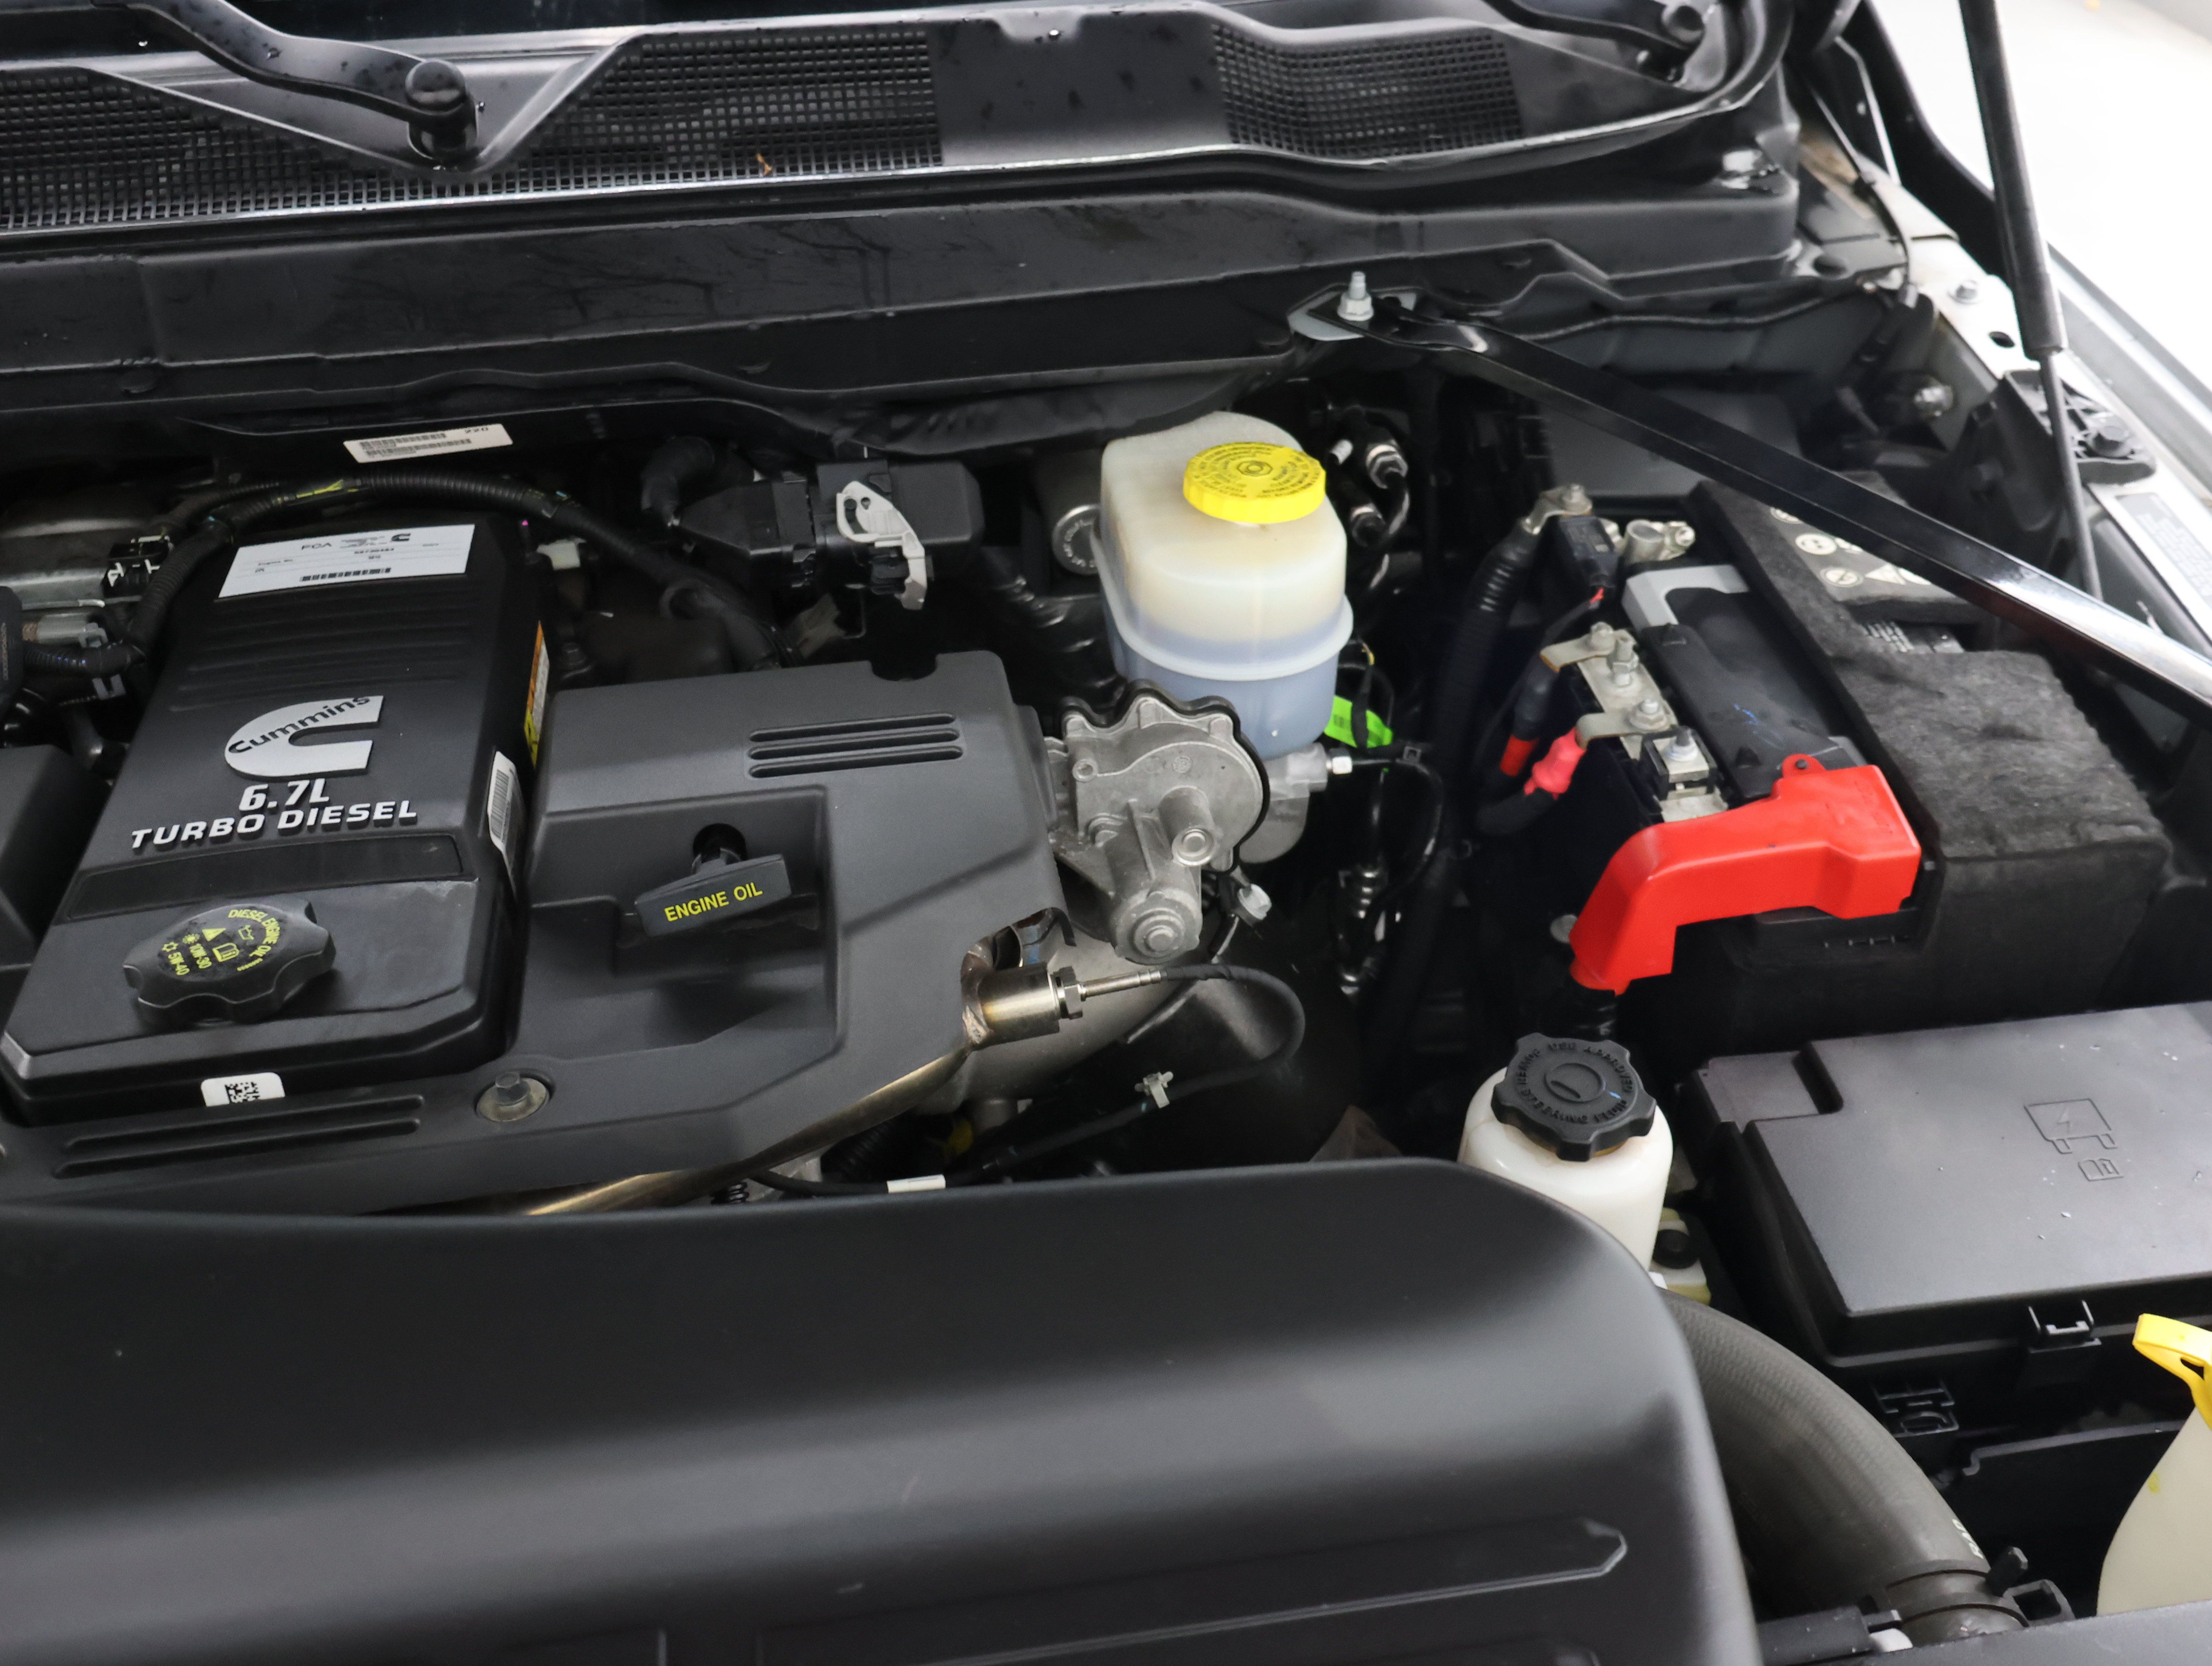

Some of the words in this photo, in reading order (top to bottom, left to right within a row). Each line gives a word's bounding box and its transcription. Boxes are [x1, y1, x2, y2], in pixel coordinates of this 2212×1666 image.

[228, 696, 371, 754] Cummins
[238, 778, 330, 811] 6.7L
[131, 813, 265, 849] TURBO
[277, 800, 417, 830] DIESEL
[664, 891, 730, 922] ENGINE
[733, 882, 764, 901] OIL
[228, 909, 268, 922] DIESEL
[249, 945, 272, 957] OIL
